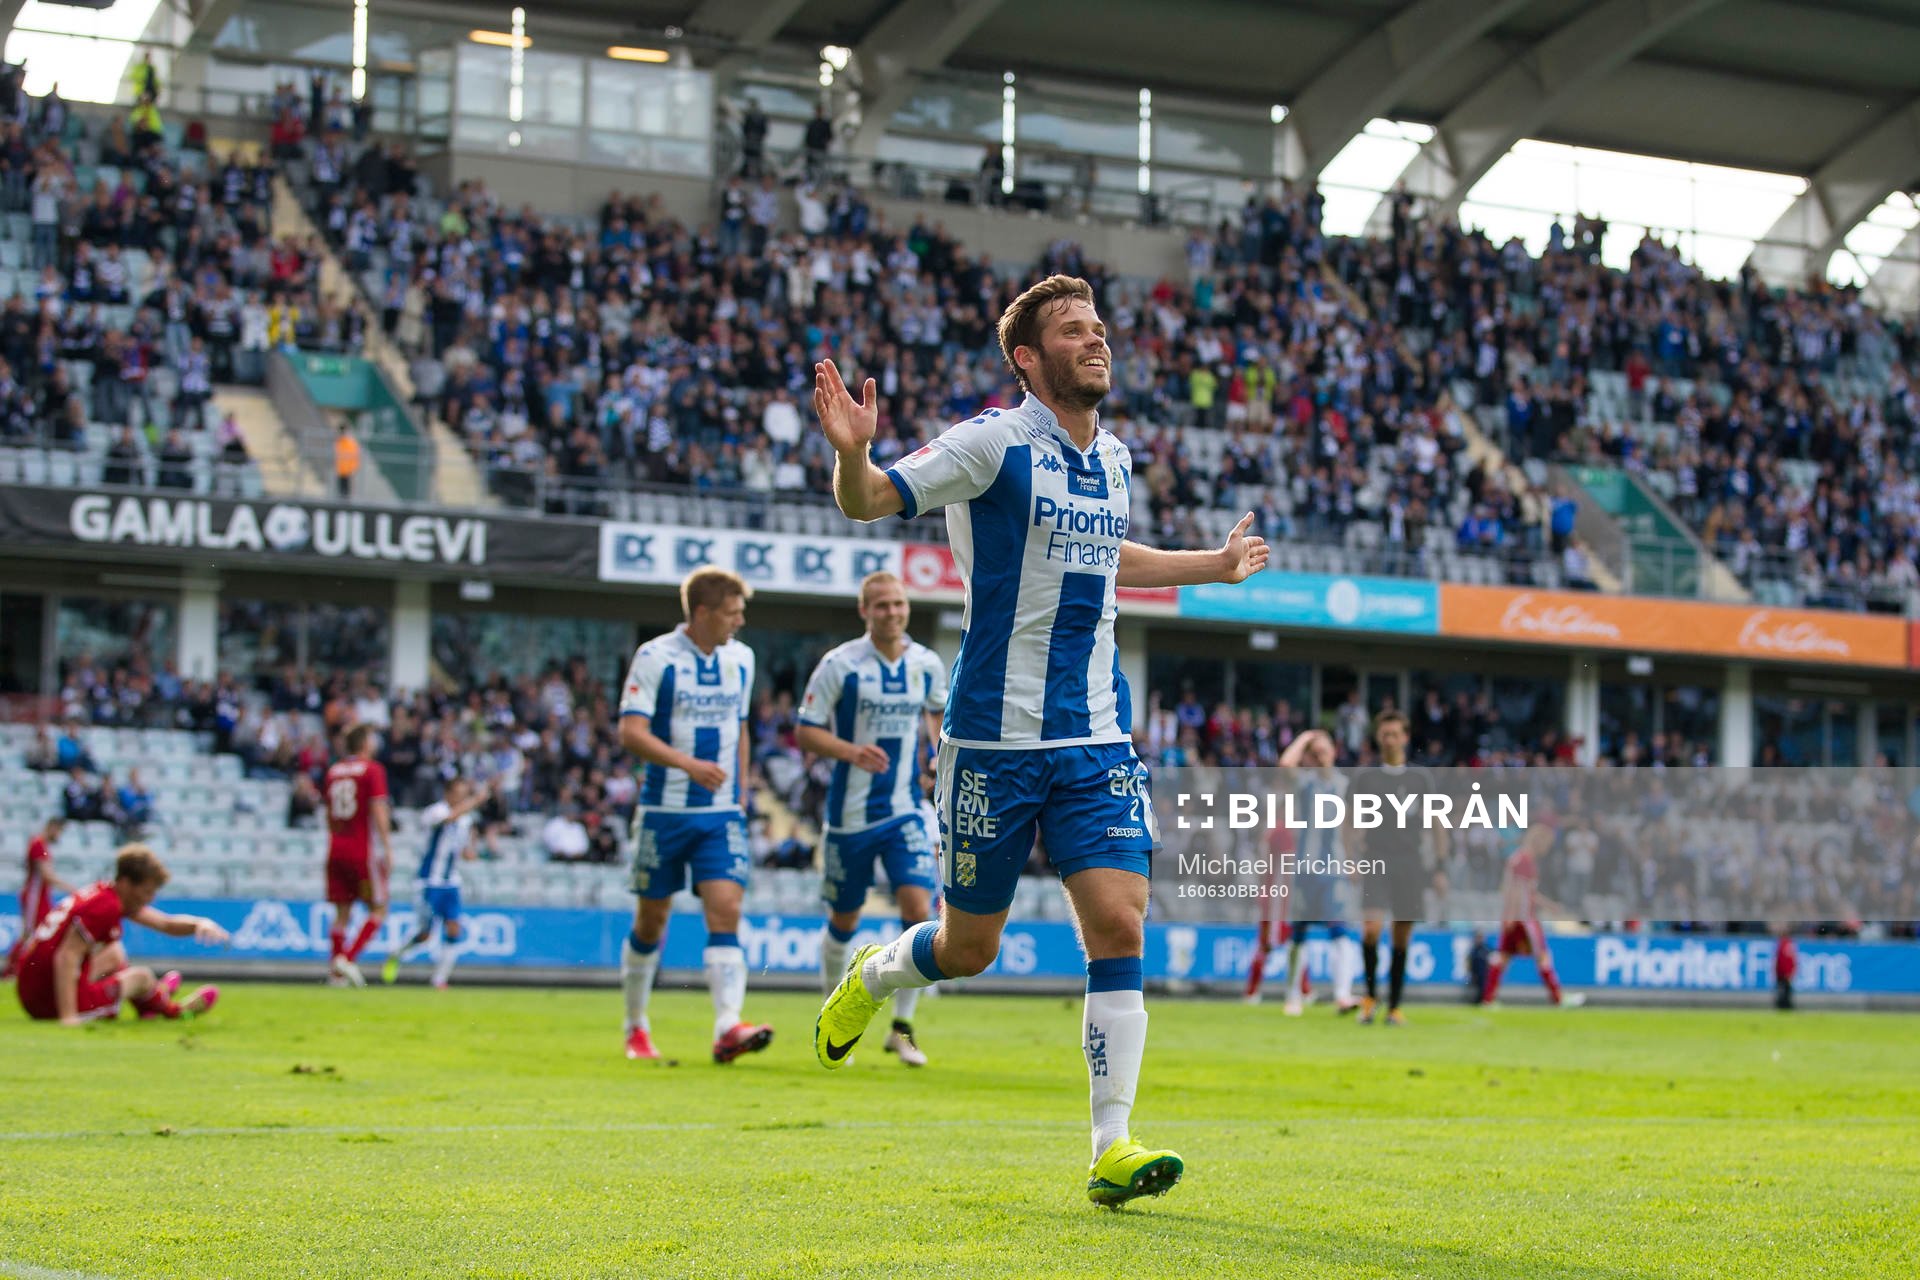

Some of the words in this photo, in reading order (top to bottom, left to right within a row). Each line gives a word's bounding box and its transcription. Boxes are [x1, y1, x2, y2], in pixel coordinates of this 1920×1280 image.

[70, 495, 264, 551] GAMLA
[313, 510, 487, 565] ULLEVI
[1034, 496, 1129, 539] Prioritet
[1047, 531, 1119, 568] Finans
[960, 769, 988, 796] SE
[957, 789, 989, 816] RN
[956, 811, 997, 838] EKE
[1107, 826, 1143, 838] Kappa
[1595, 937, 1743, 988] Prioritet
[1089, 1022, 1108, 1077] SKF
